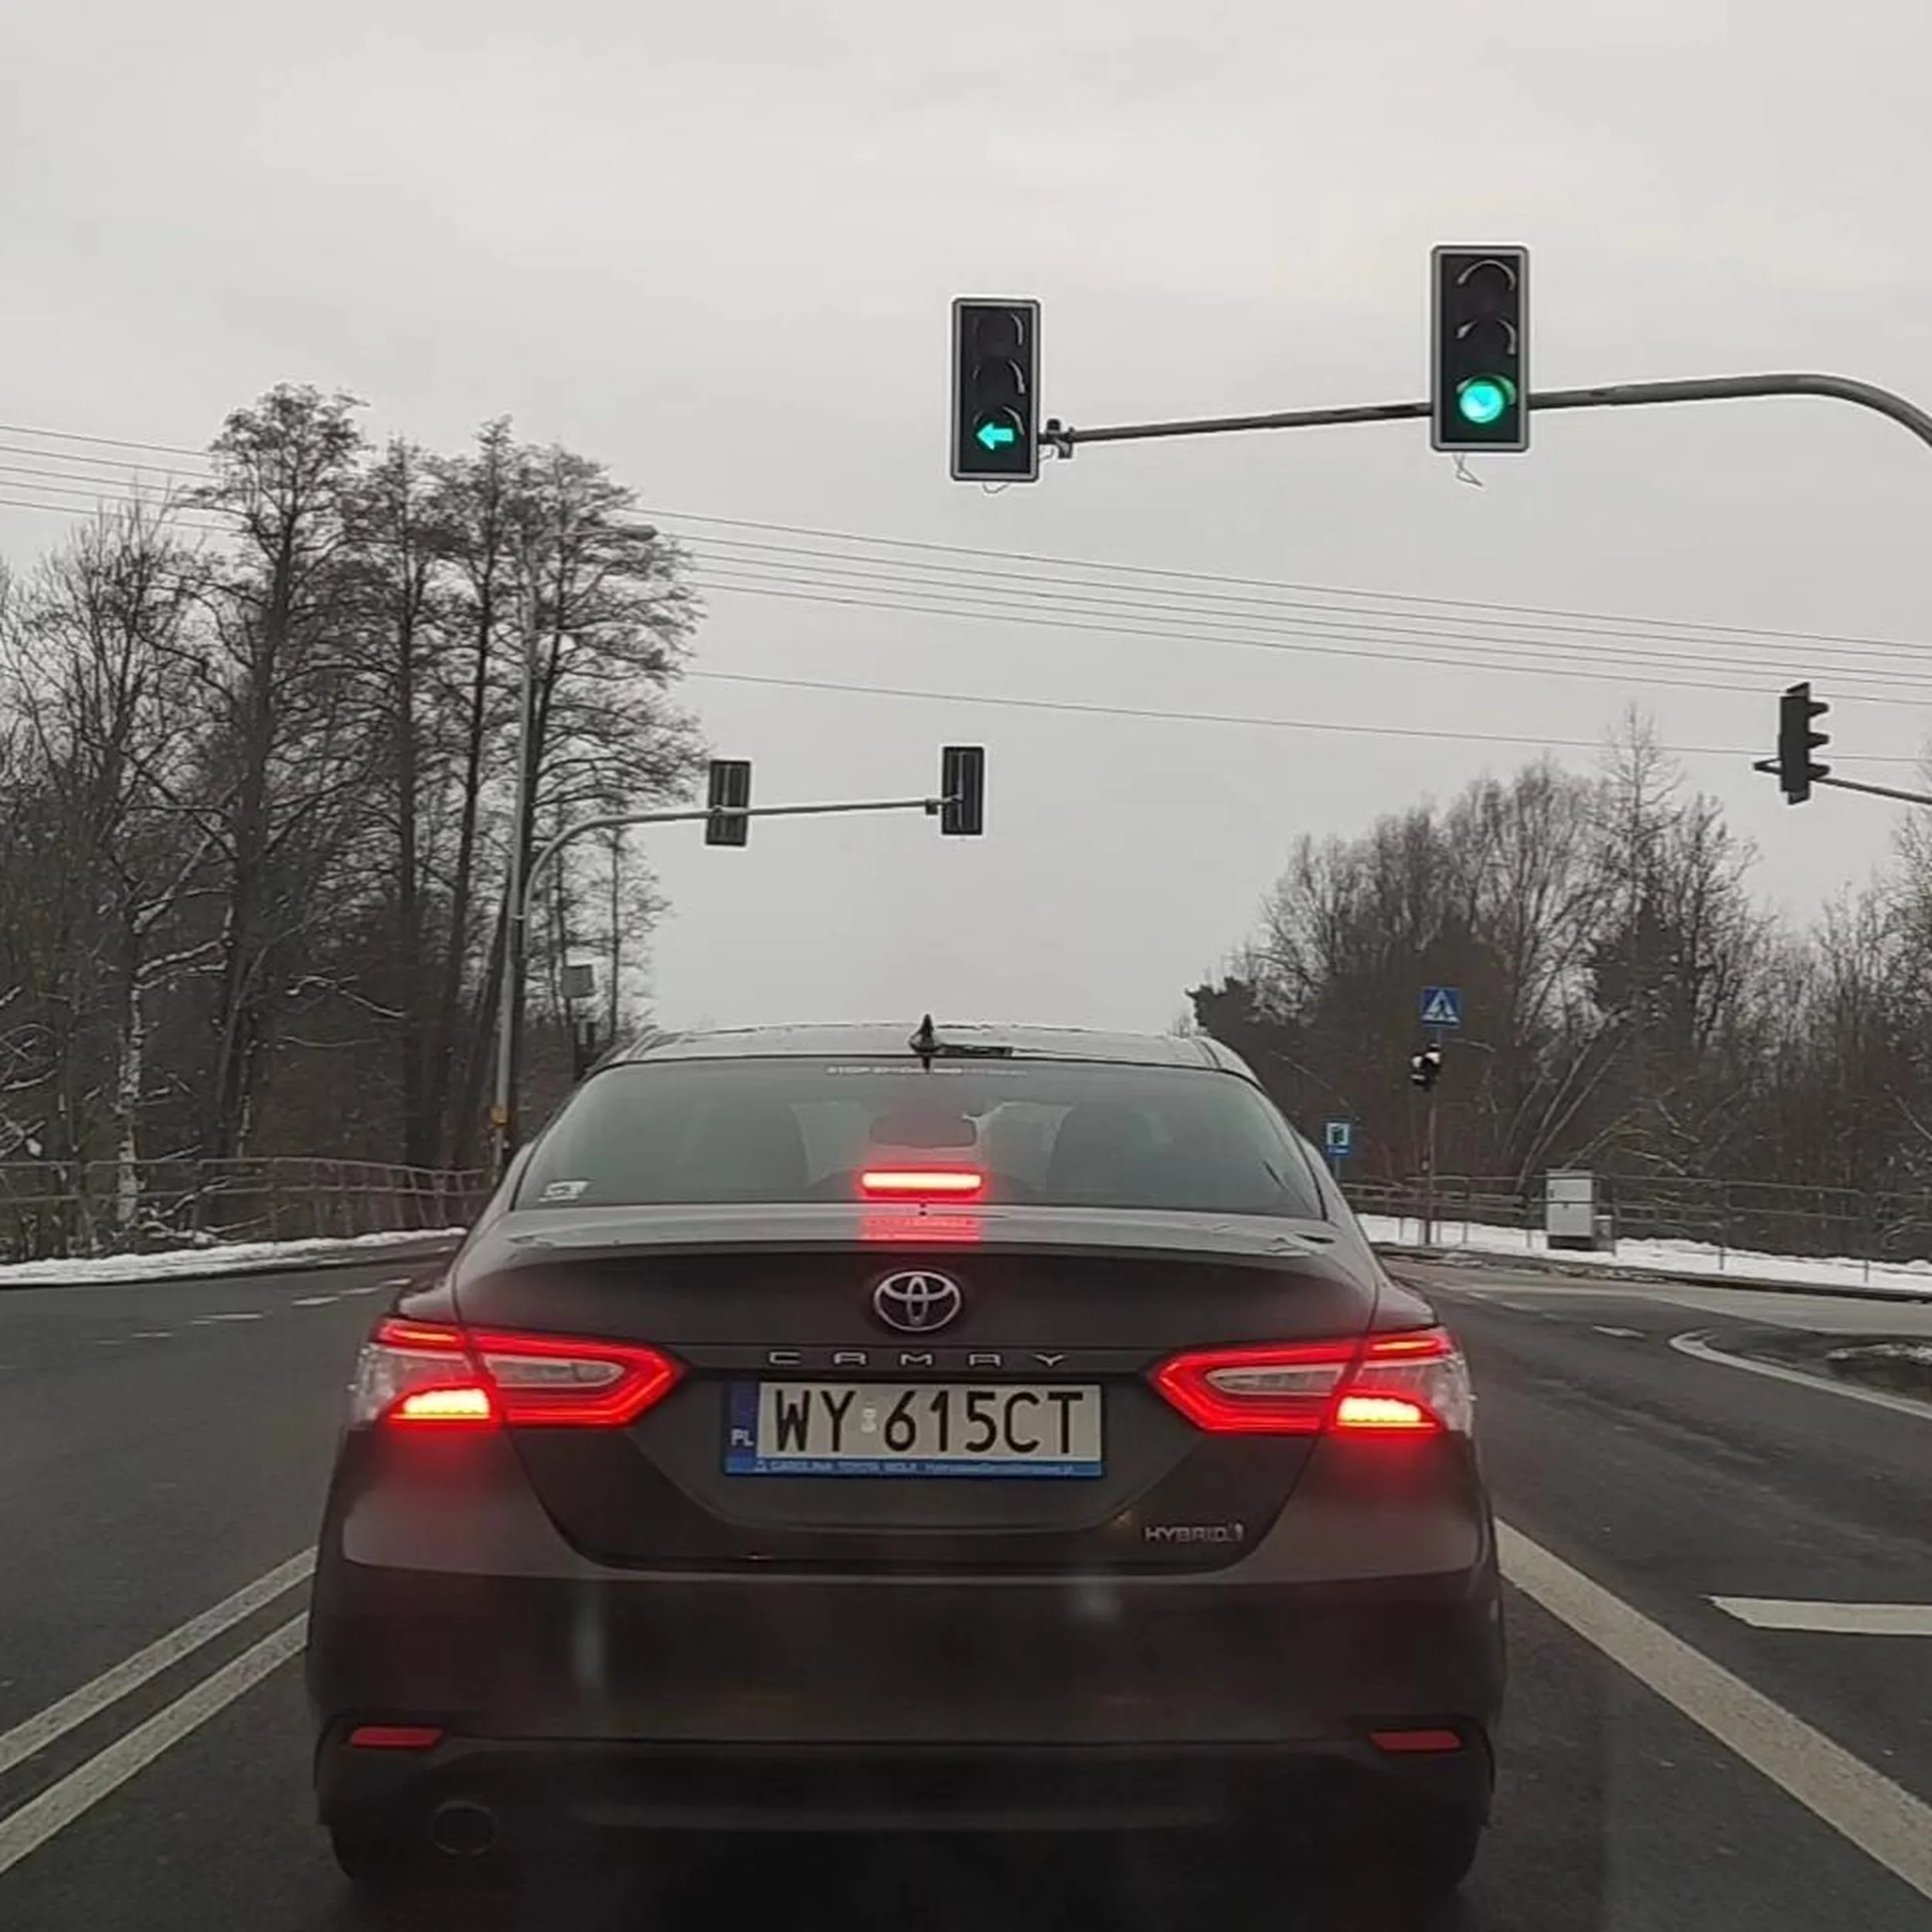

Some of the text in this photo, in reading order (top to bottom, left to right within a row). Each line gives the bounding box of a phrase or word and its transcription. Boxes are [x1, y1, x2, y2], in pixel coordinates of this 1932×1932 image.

[769, 1351, 1065, 1367] CAMRY
[775, 1389, 1083, 1453] WY 615CT
[731, 1429, 754, 1447] PL
[1145, 1526, 1228, 1543] HYBRID
